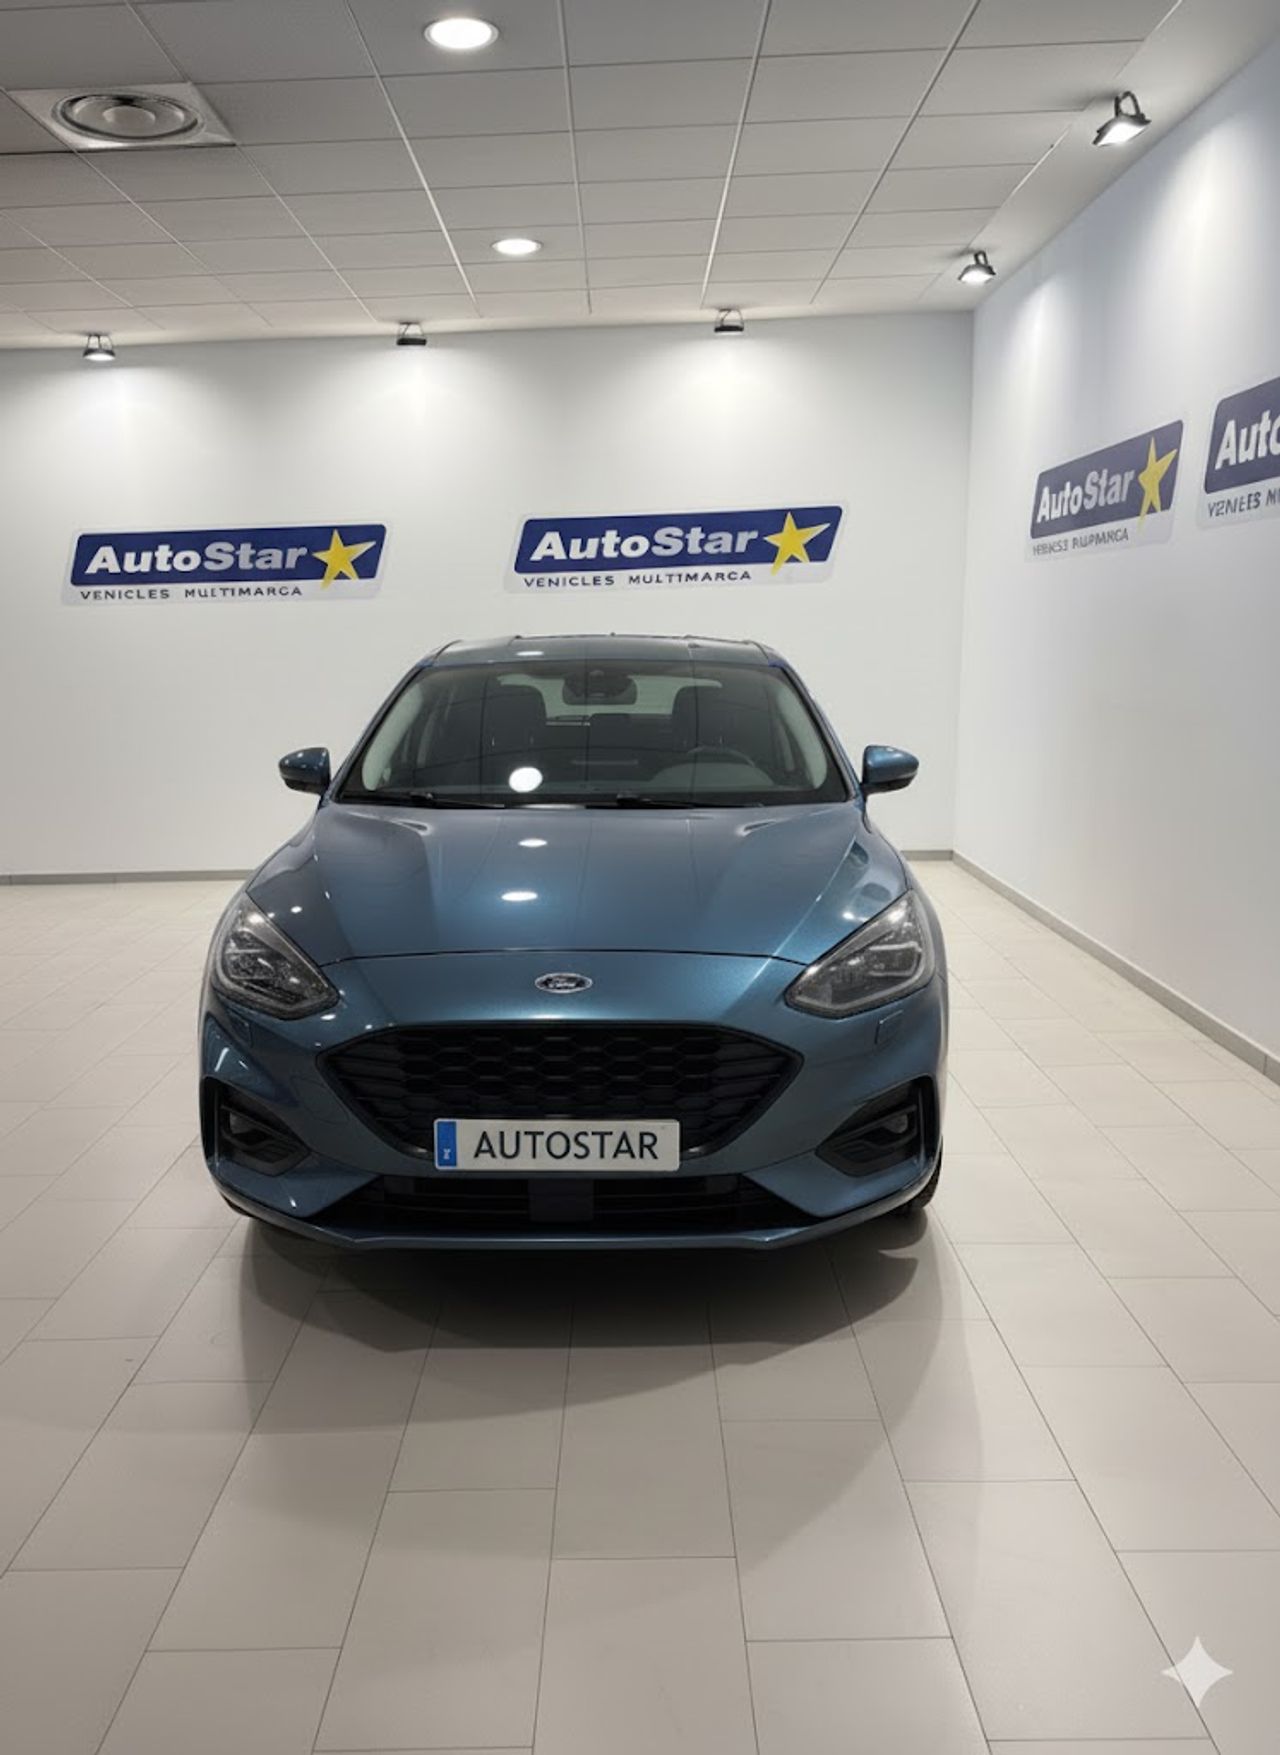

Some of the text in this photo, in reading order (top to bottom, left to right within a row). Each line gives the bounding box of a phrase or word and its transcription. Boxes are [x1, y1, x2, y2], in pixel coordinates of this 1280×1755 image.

[1036, 468, 1135, 523] AutoStar
[85, 541, 308, 575] AutoStar
[529, 526, 758, 561] AutoStar
[80, 586, 302, 600] VENICLES MULTIMARCA
[523, 570, 751, 587] VENICLES MULTIMARCA
[473, 1131, 659, 1160] AUTOSTAR
